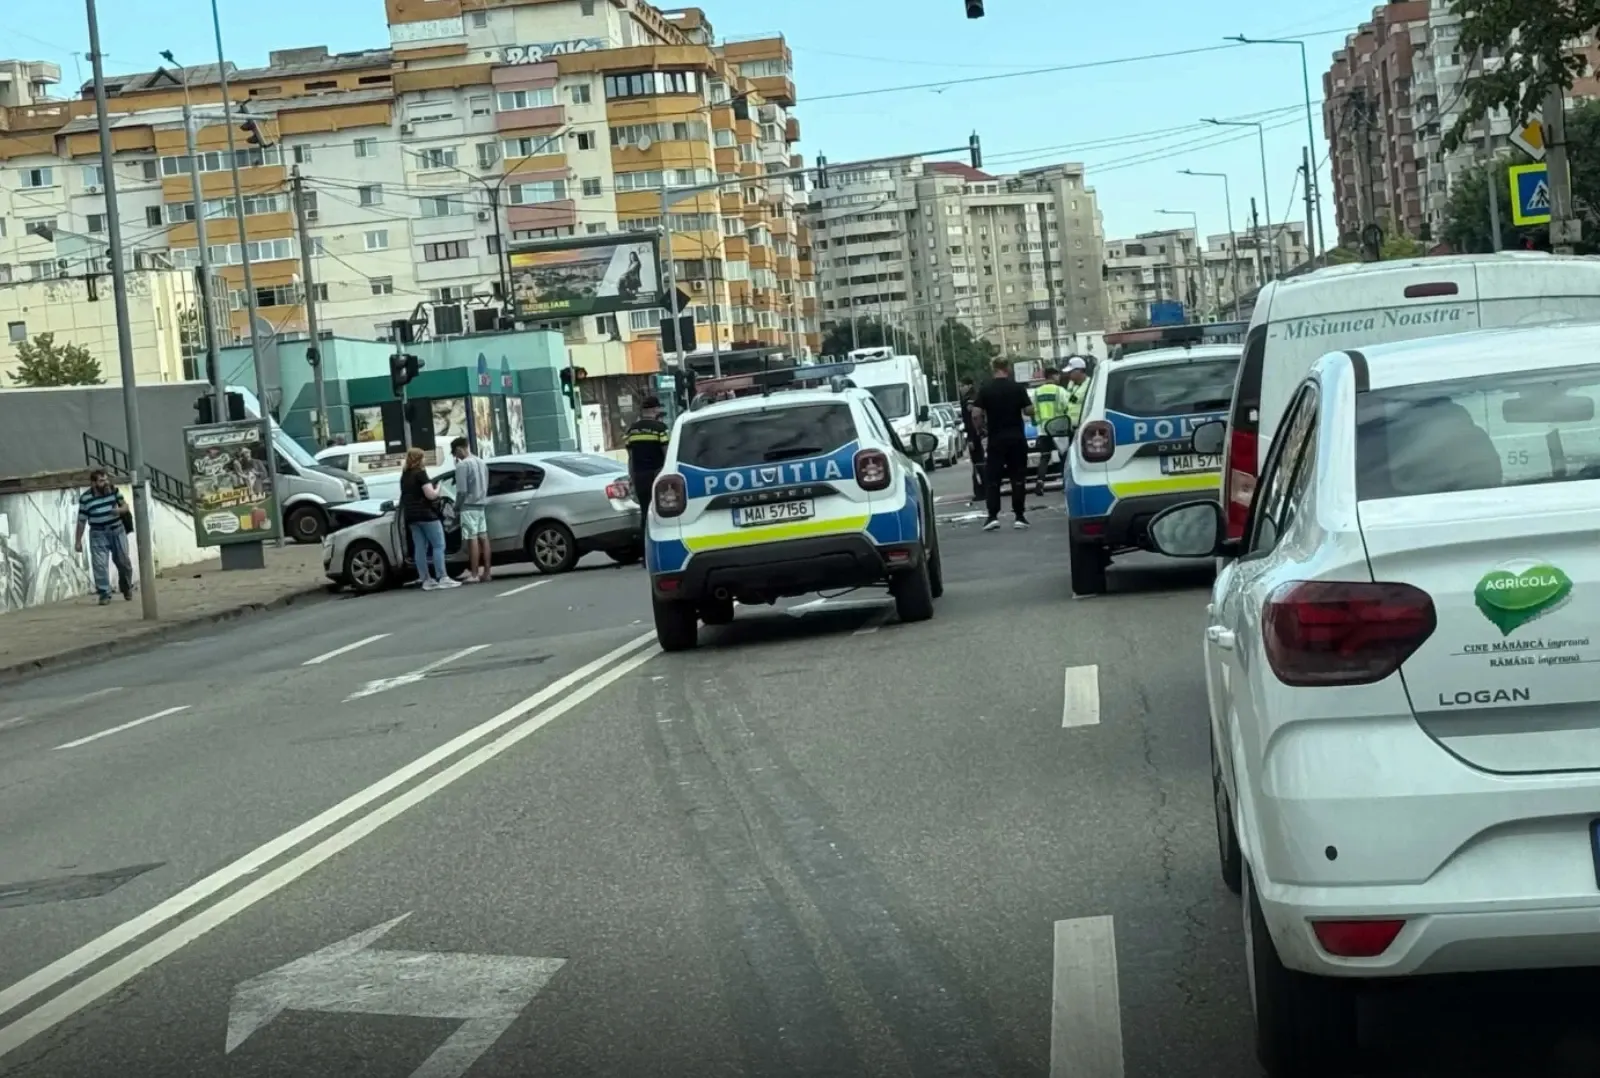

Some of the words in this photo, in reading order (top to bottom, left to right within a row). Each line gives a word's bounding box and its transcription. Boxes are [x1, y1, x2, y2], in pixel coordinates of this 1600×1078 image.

[1284, 317, 1374, 341] Misiunea
[1382, 307, 1460, 328] Noastra
[1172, 455, 1193, 471] MAI
[744, 508, 766, 523] MAI
[771, 501, 808, 519] 57156
[1485, 575, 1558, 591] AGRICOLA
[1463, 643, 1488, 653] CINE
[1439, 687, 1530, 706] LOGAN
